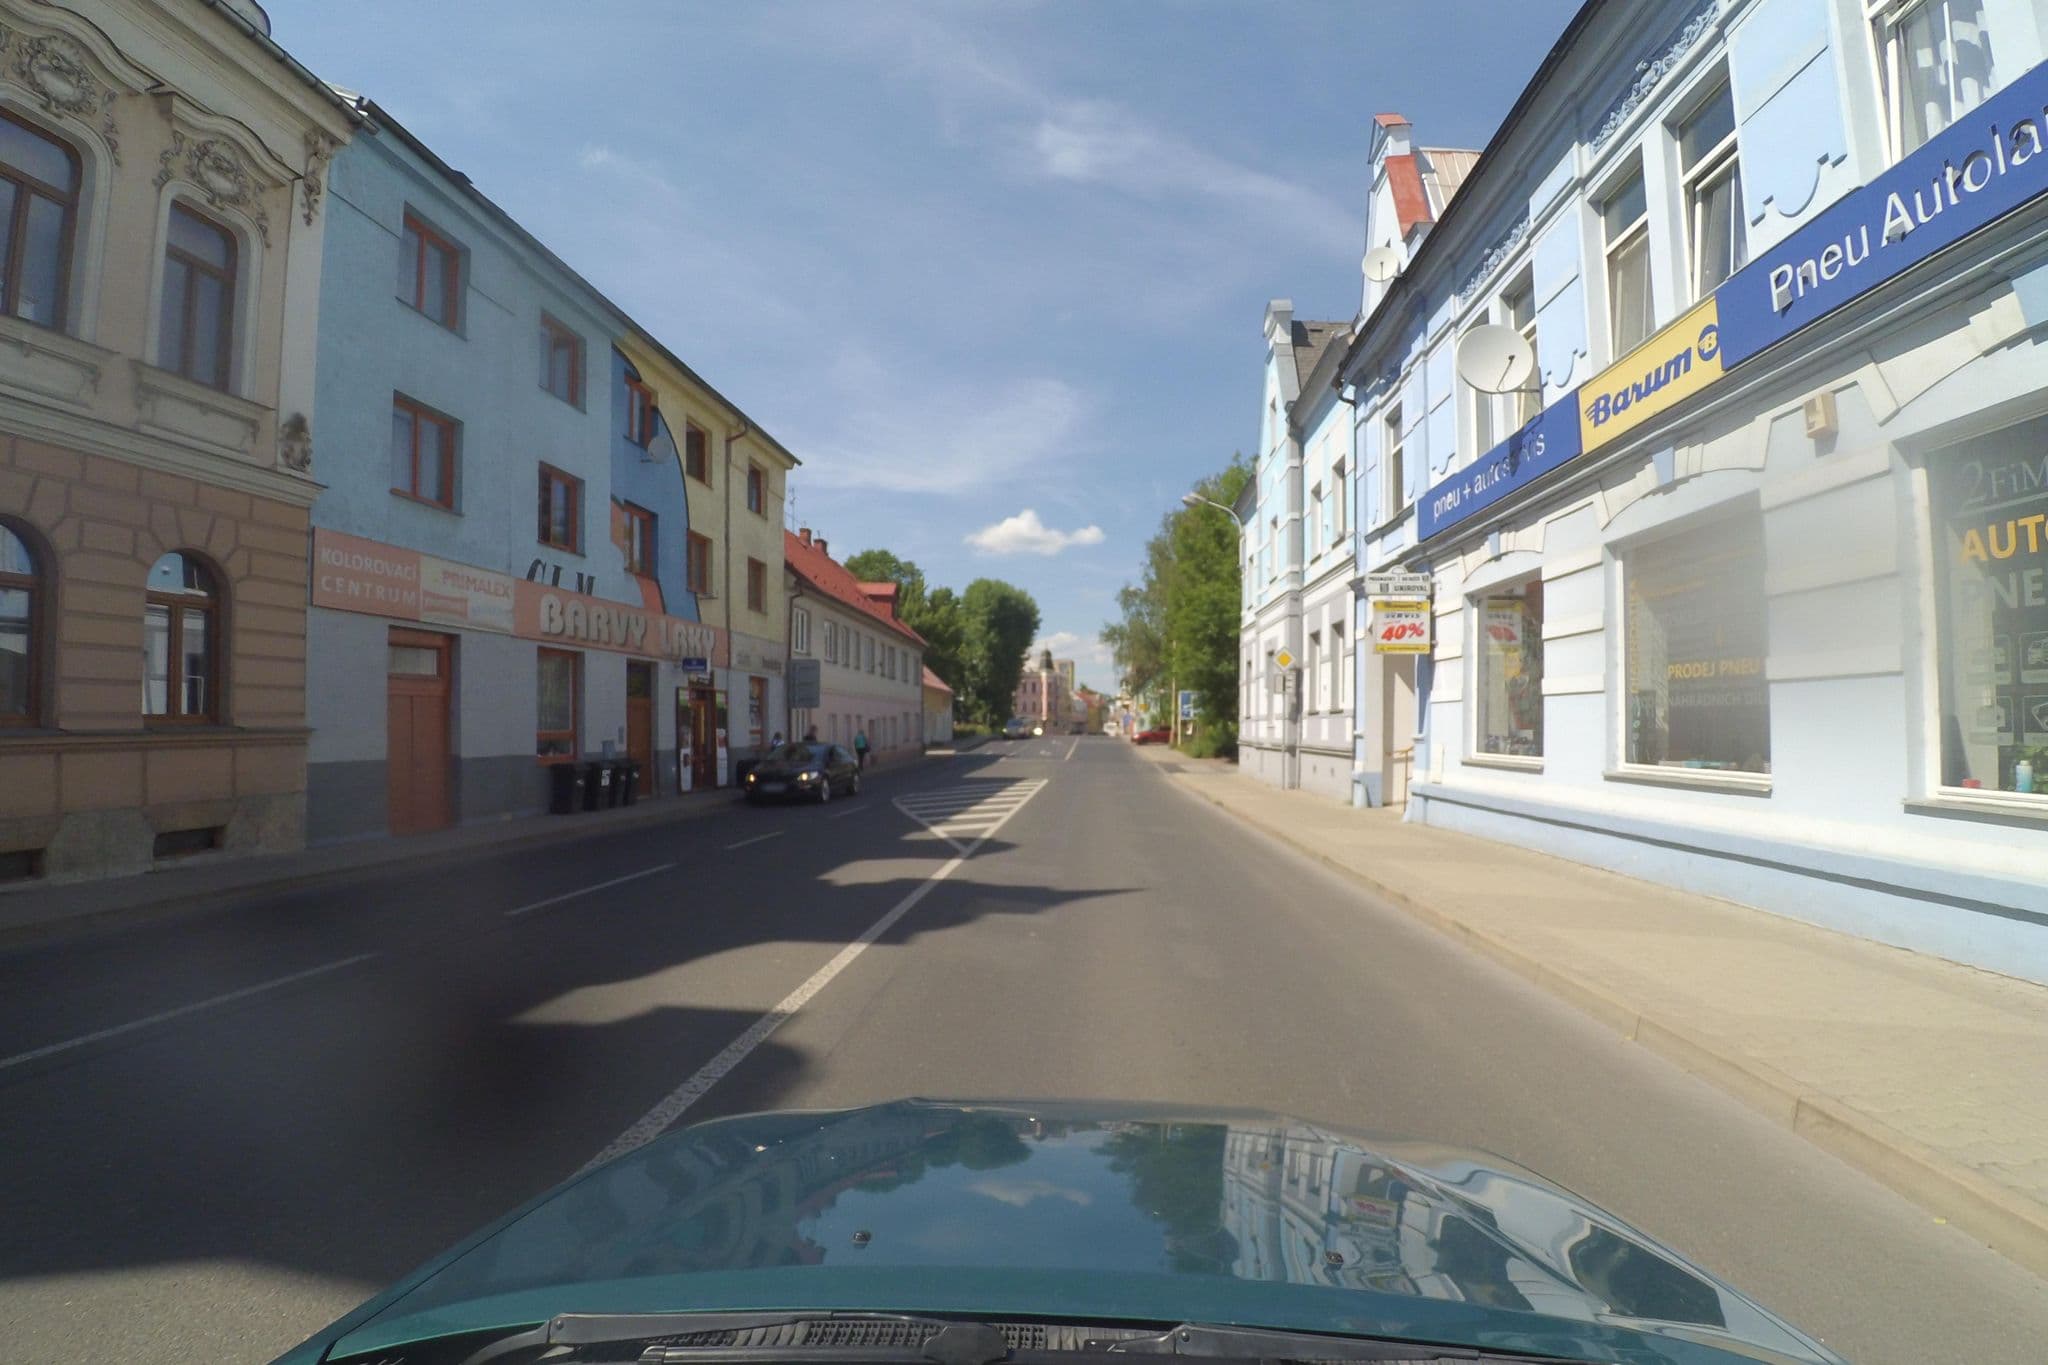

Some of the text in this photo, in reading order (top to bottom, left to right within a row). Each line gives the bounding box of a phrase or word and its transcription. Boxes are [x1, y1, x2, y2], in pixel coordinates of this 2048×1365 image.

[1769, 104, 2048, 313] Pneu Autola
[1585, 347, 1692, 428] Barum
[1434, 488, 1460, 524] pneu
[1960, 514, 2048, 567] AUT
[320, 575, 417, 608] CENTRUM
[539, 594, 647, 648] BARVY
[1381, 622, 1425, 641] 40%
[1668, 662, 1715, 679] PRODEJ
